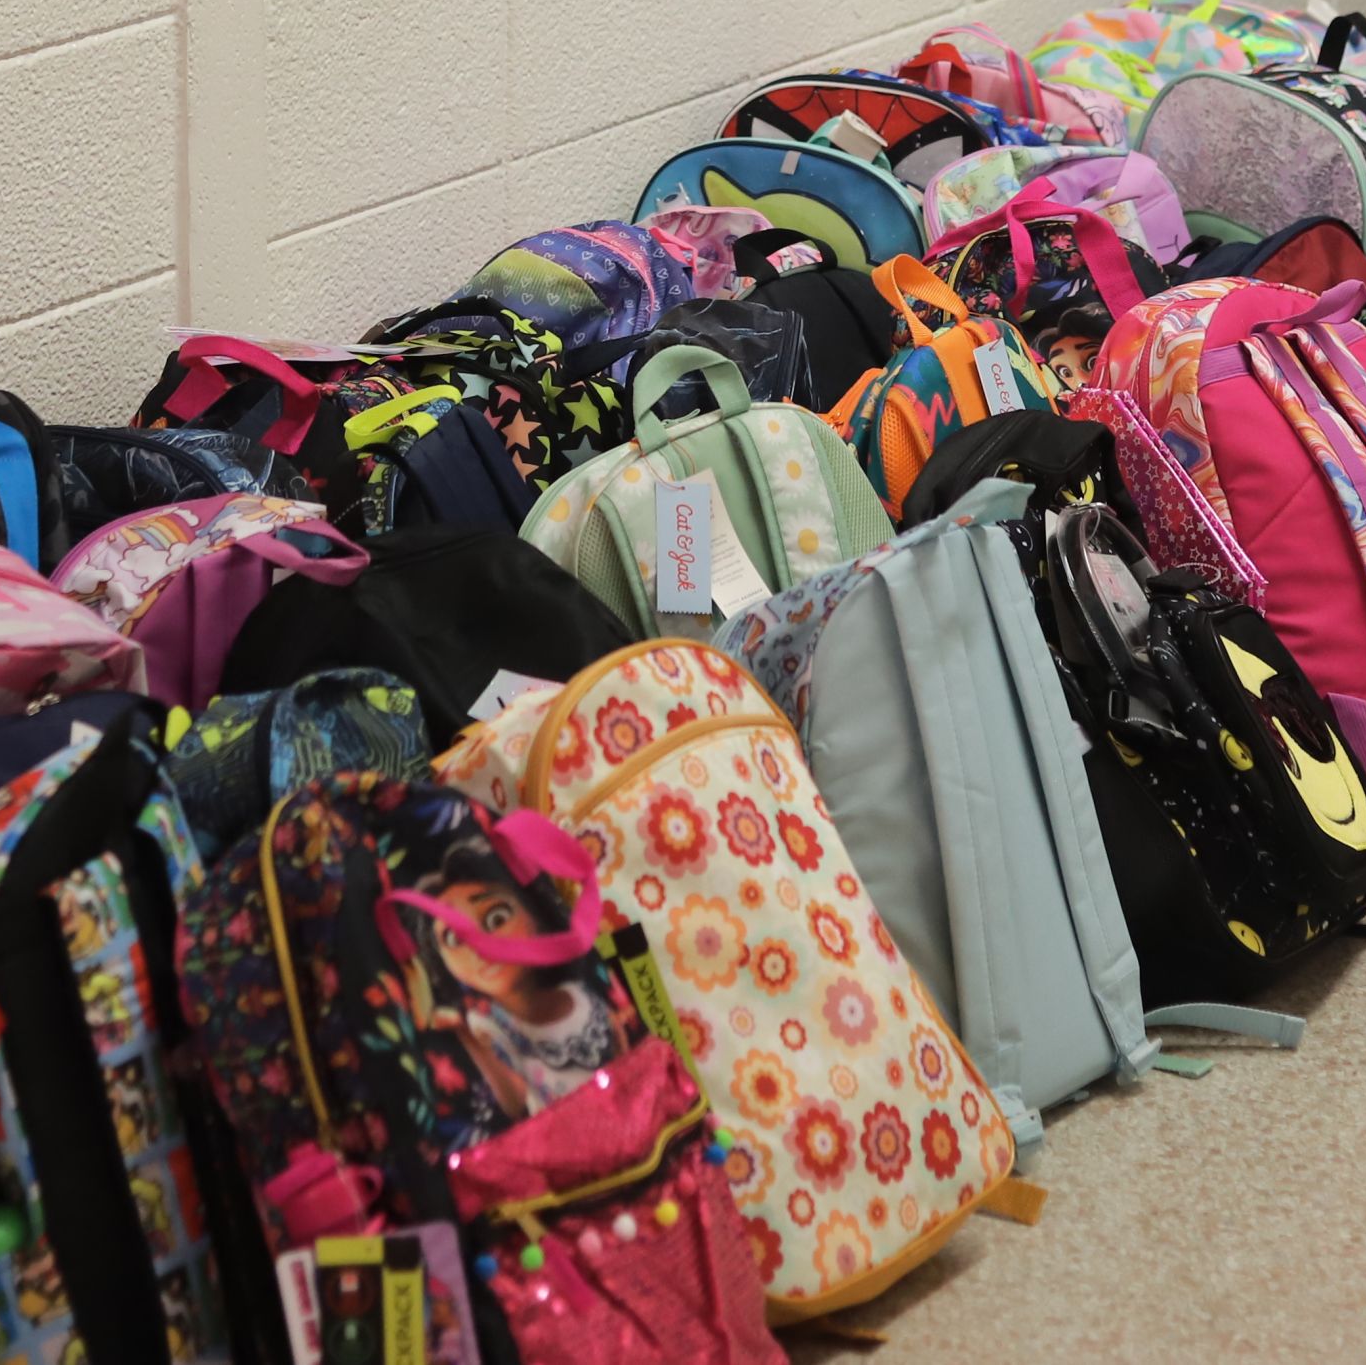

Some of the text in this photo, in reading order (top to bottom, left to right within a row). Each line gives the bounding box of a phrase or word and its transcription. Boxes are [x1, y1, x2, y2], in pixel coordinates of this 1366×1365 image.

[990, 362, 1006, 390] Cat
[668, 503, 696, 593] Cat & Jack
